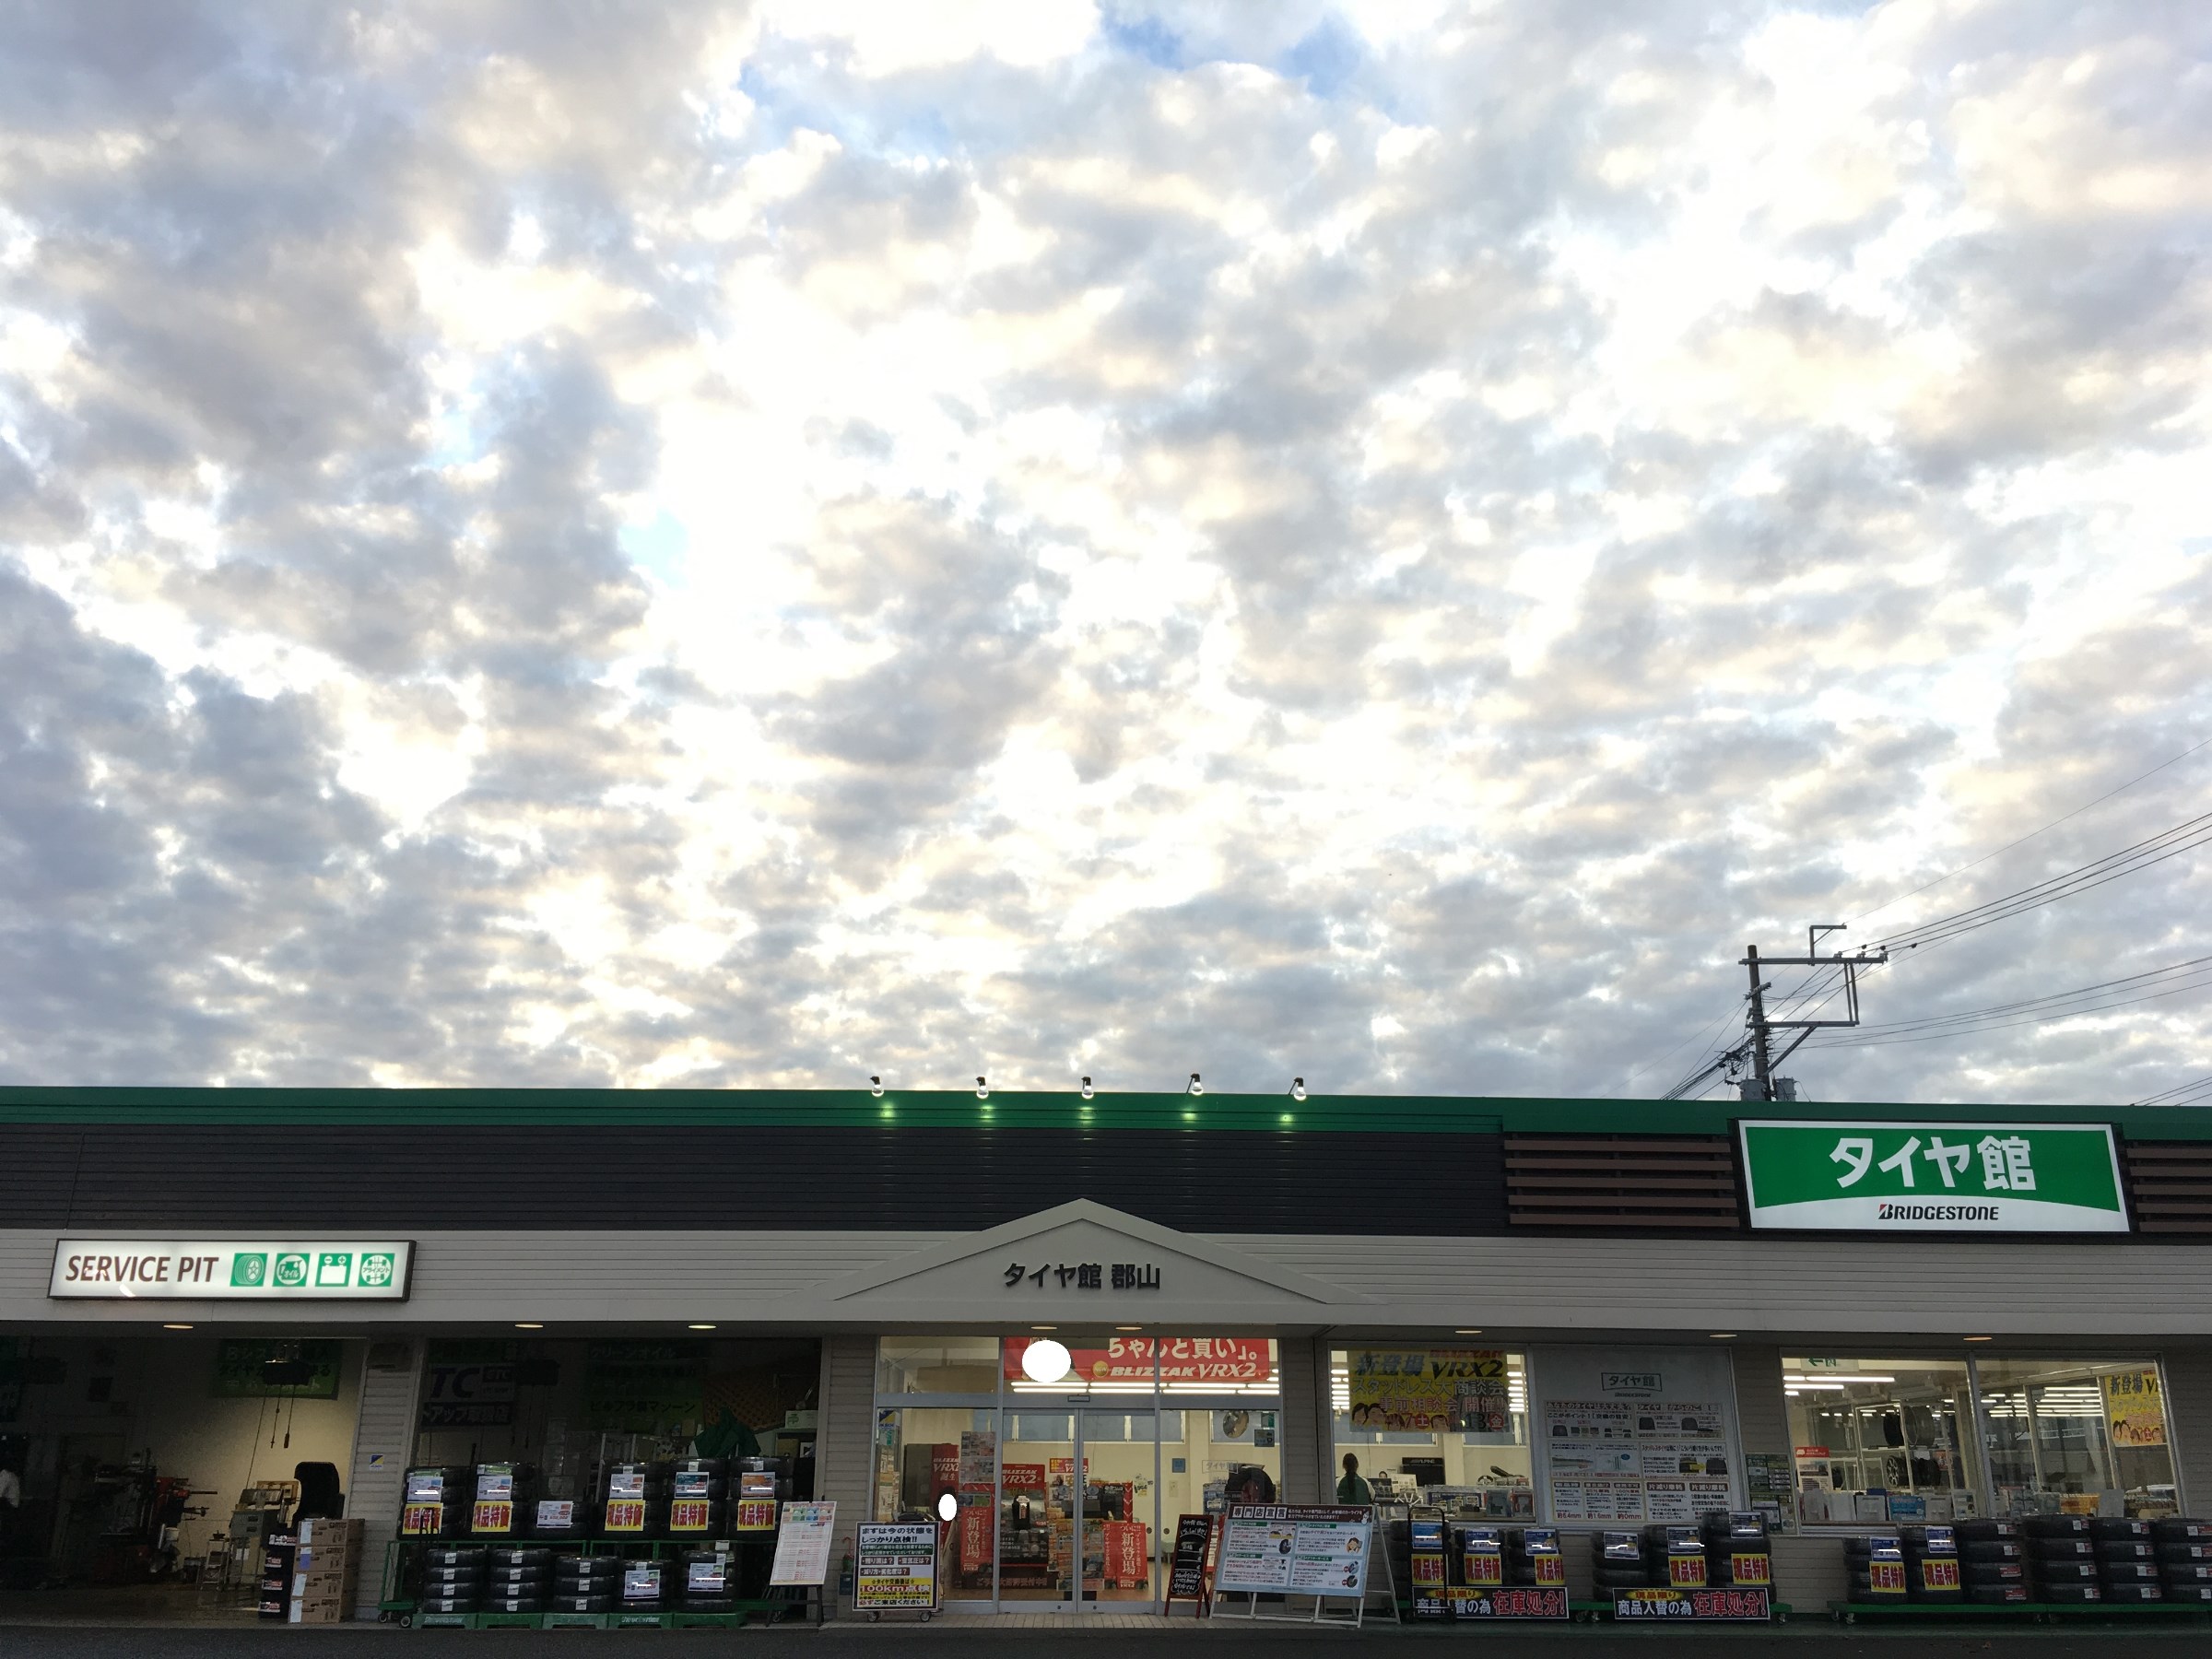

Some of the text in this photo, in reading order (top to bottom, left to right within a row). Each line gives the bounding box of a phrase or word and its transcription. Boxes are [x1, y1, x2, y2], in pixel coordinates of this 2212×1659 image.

[1829, 1135, 2037, 1191] タイヤ館
[1878, 1204, 1999, 1221] BRIDGESTONE
[65, 1255, 219, 1282] SERVICE PIT
[283, 1270, 300, 1278] オイル
[1004, 1263, 1160, 1289] タイヤ館 郡山
[1110, 1362, 1257, 1379] BLIZZAK VRX2
[1354, 1354, 1504, 1380] 新登場 VRX2
[429, 1367, 481, 1398] TC
[1352, 1379, 1504, 1396] スタッドレス大商談会
[1609, 1375, 1655, 1386] タイヤ館
[1003, 1475, 1037, 1484] VRX2
[606, 1503, 643, 1527] 現品特価
[672, 1503, 708, 1527] 現品特価
[738, 1503, 775, 1527] 現品特価
[1121, 1532, 1135, 1575] 新登場
[1493, 1590, 1565, 1616] 在庫処分!
[1618, 1591, 1767, 1617] 商品入替の為 在庫処分!
